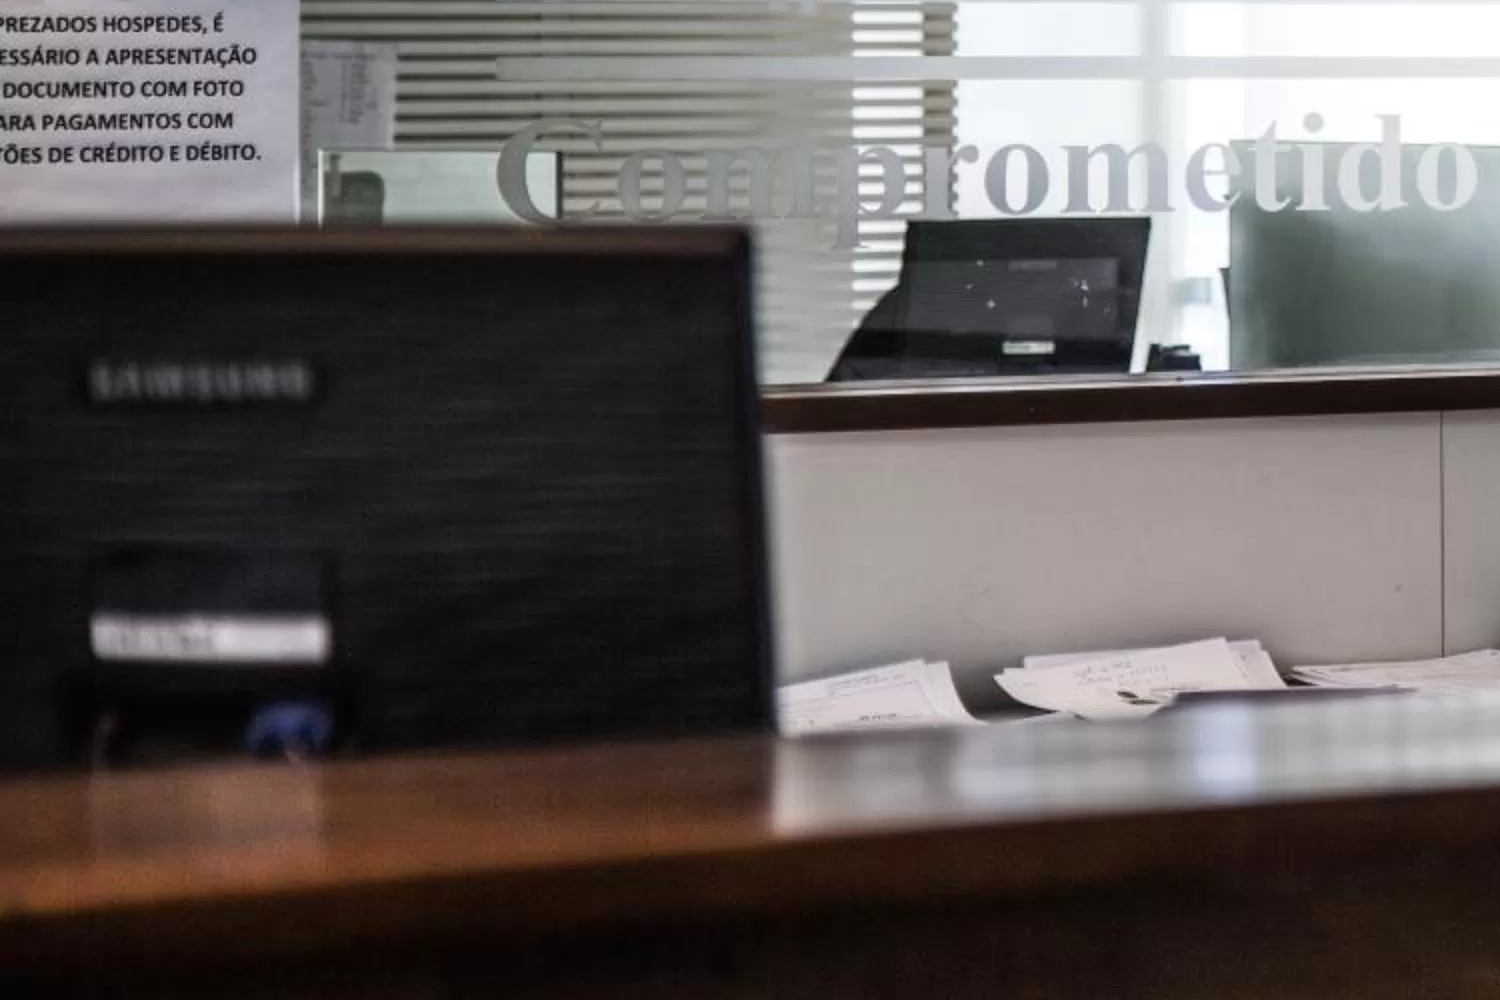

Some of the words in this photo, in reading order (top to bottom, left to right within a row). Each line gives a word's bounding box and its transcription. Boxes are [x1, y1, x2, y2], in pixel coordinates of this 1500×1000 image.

[103, 15, 207, 35] HOSPEDES,
[213, 11, 224, 33] É
[85, 48, 99, 66] A
[105, 43, 257, 68] APRESENTAÇÃO
[3, 81, 135, 99] DOCUMENTO
[141, 81, 187, 97] COM
[194, 80, 244, 97] FOTO
[42, 113, 182, 131] PAGAMENTOS
[187, 112, 234, 130] COM
[0, 143, 43, 165] ÕES
[48, 146, 74, 163] DE
[80, 141, 164, 163] CRÉDITO
[170, 145, 180, 162] E
[186, 140, 262, 162] DÉBITO.
[495, 111, 1480, 248] Comprometido
